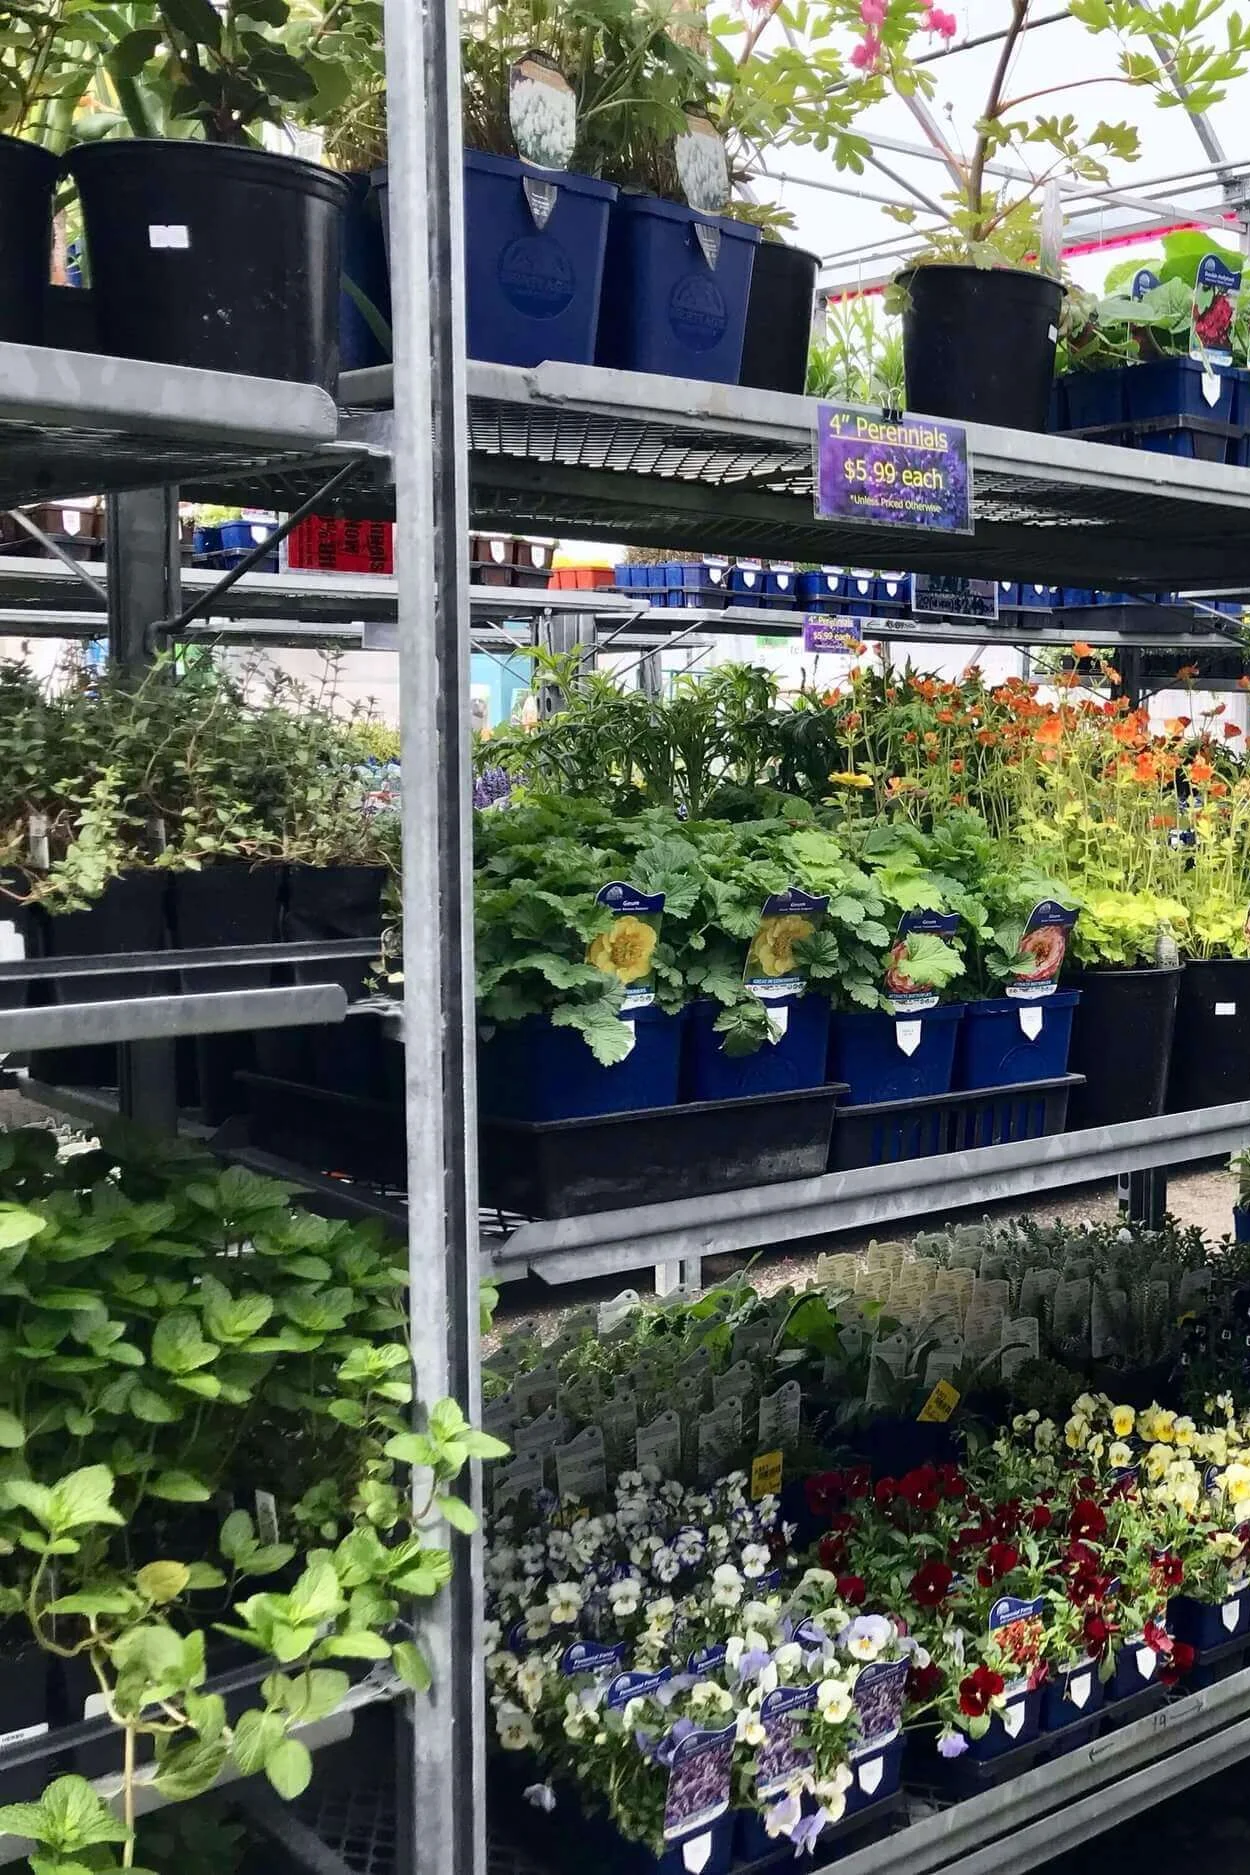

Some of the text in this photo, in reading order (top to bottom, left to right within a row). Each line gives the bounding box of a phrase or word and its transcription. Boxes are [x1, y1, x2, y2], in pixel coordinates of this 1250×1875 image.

[829, 413, 948, 448] 4" Perennials
[844, 458, 943, 489] $5.99 each
